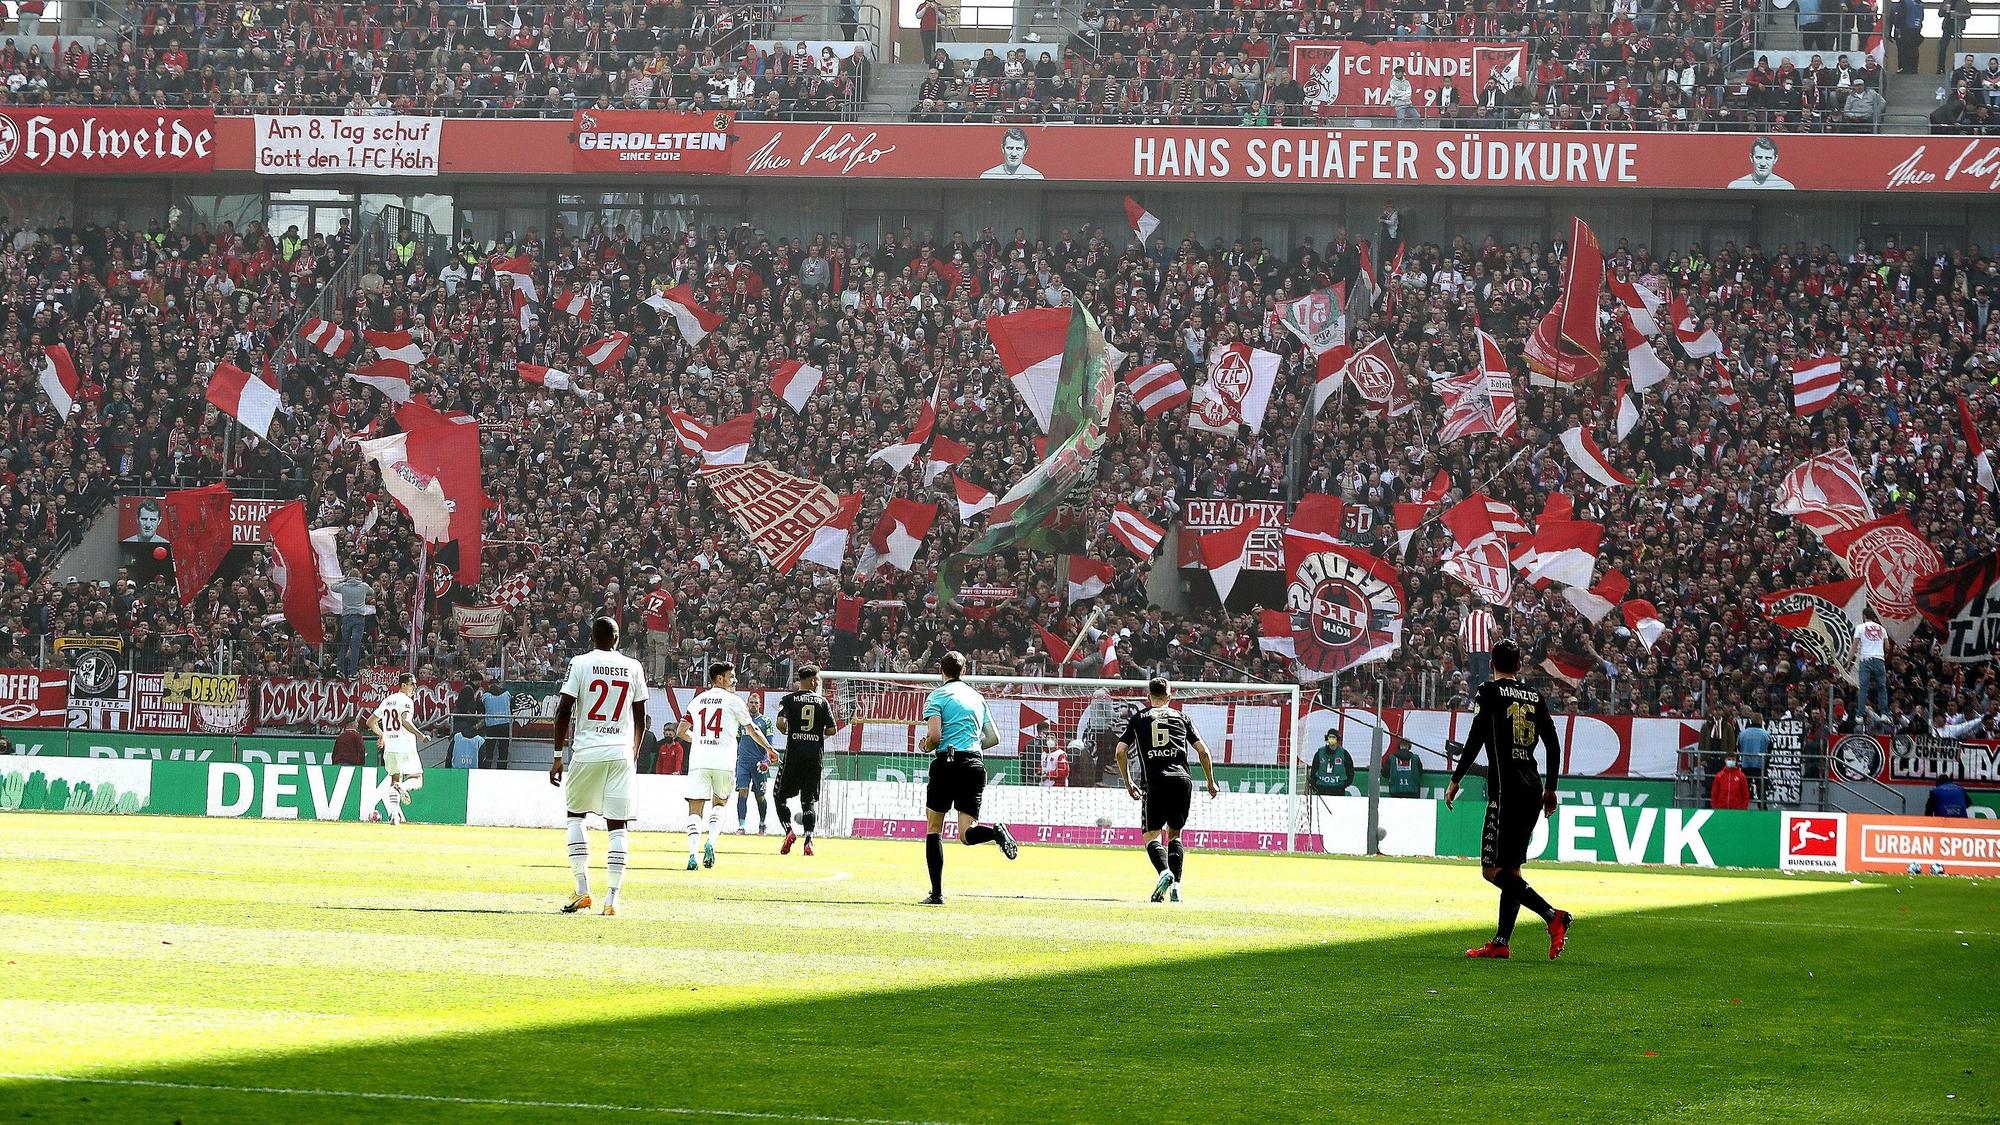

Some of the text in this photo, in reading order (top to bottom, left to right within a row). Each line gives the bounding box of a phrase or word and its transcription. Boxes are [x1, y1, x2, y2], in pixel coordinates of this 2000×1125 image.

[1344, 52, 1472, 77] FC FRÜNDE
[24, 115, 212, 166] Holweide
[268, 118, 431, 144] Am 8. Tag schuf
[578, 131, 728, 151] GEROLSTEIN
[260, 146, 433, 170] Gott den 1. FC Köln
[619, 152, 681, 161] SINCE 2012
[1133, 132, 1638, 183] HANS SCHÄFER SÜDKURVE
[1188, 501, 1284, 528] CHAOTIX
[647, 597, 664, 613] 12
[592, 665, 629, 677] MODESTE
[191, 675, 218, 702] DES
[219, 678, 238, 703] 99
[587, 679, 630, 722] 27
[1499, 686, 1529, 700] MAINZ
[75, 700, 120, 708] REVOLTE
[384, 708, 401, 731] 28
[698, 707, 723, 739] 14
[801, 704, 815, 732] 9
[1506, 701, 1536, 747] 16
[1151, 718, 1170, 748] 6
[1148, 749, 1179, 759] STACH
[1915, 745, 1938, 758] CON
[206, 762, 403, 823] DEVK
[1874, 833, 1935, 855] URBAN
[1788, 859, 1838, 867] BUNDESLIGA
